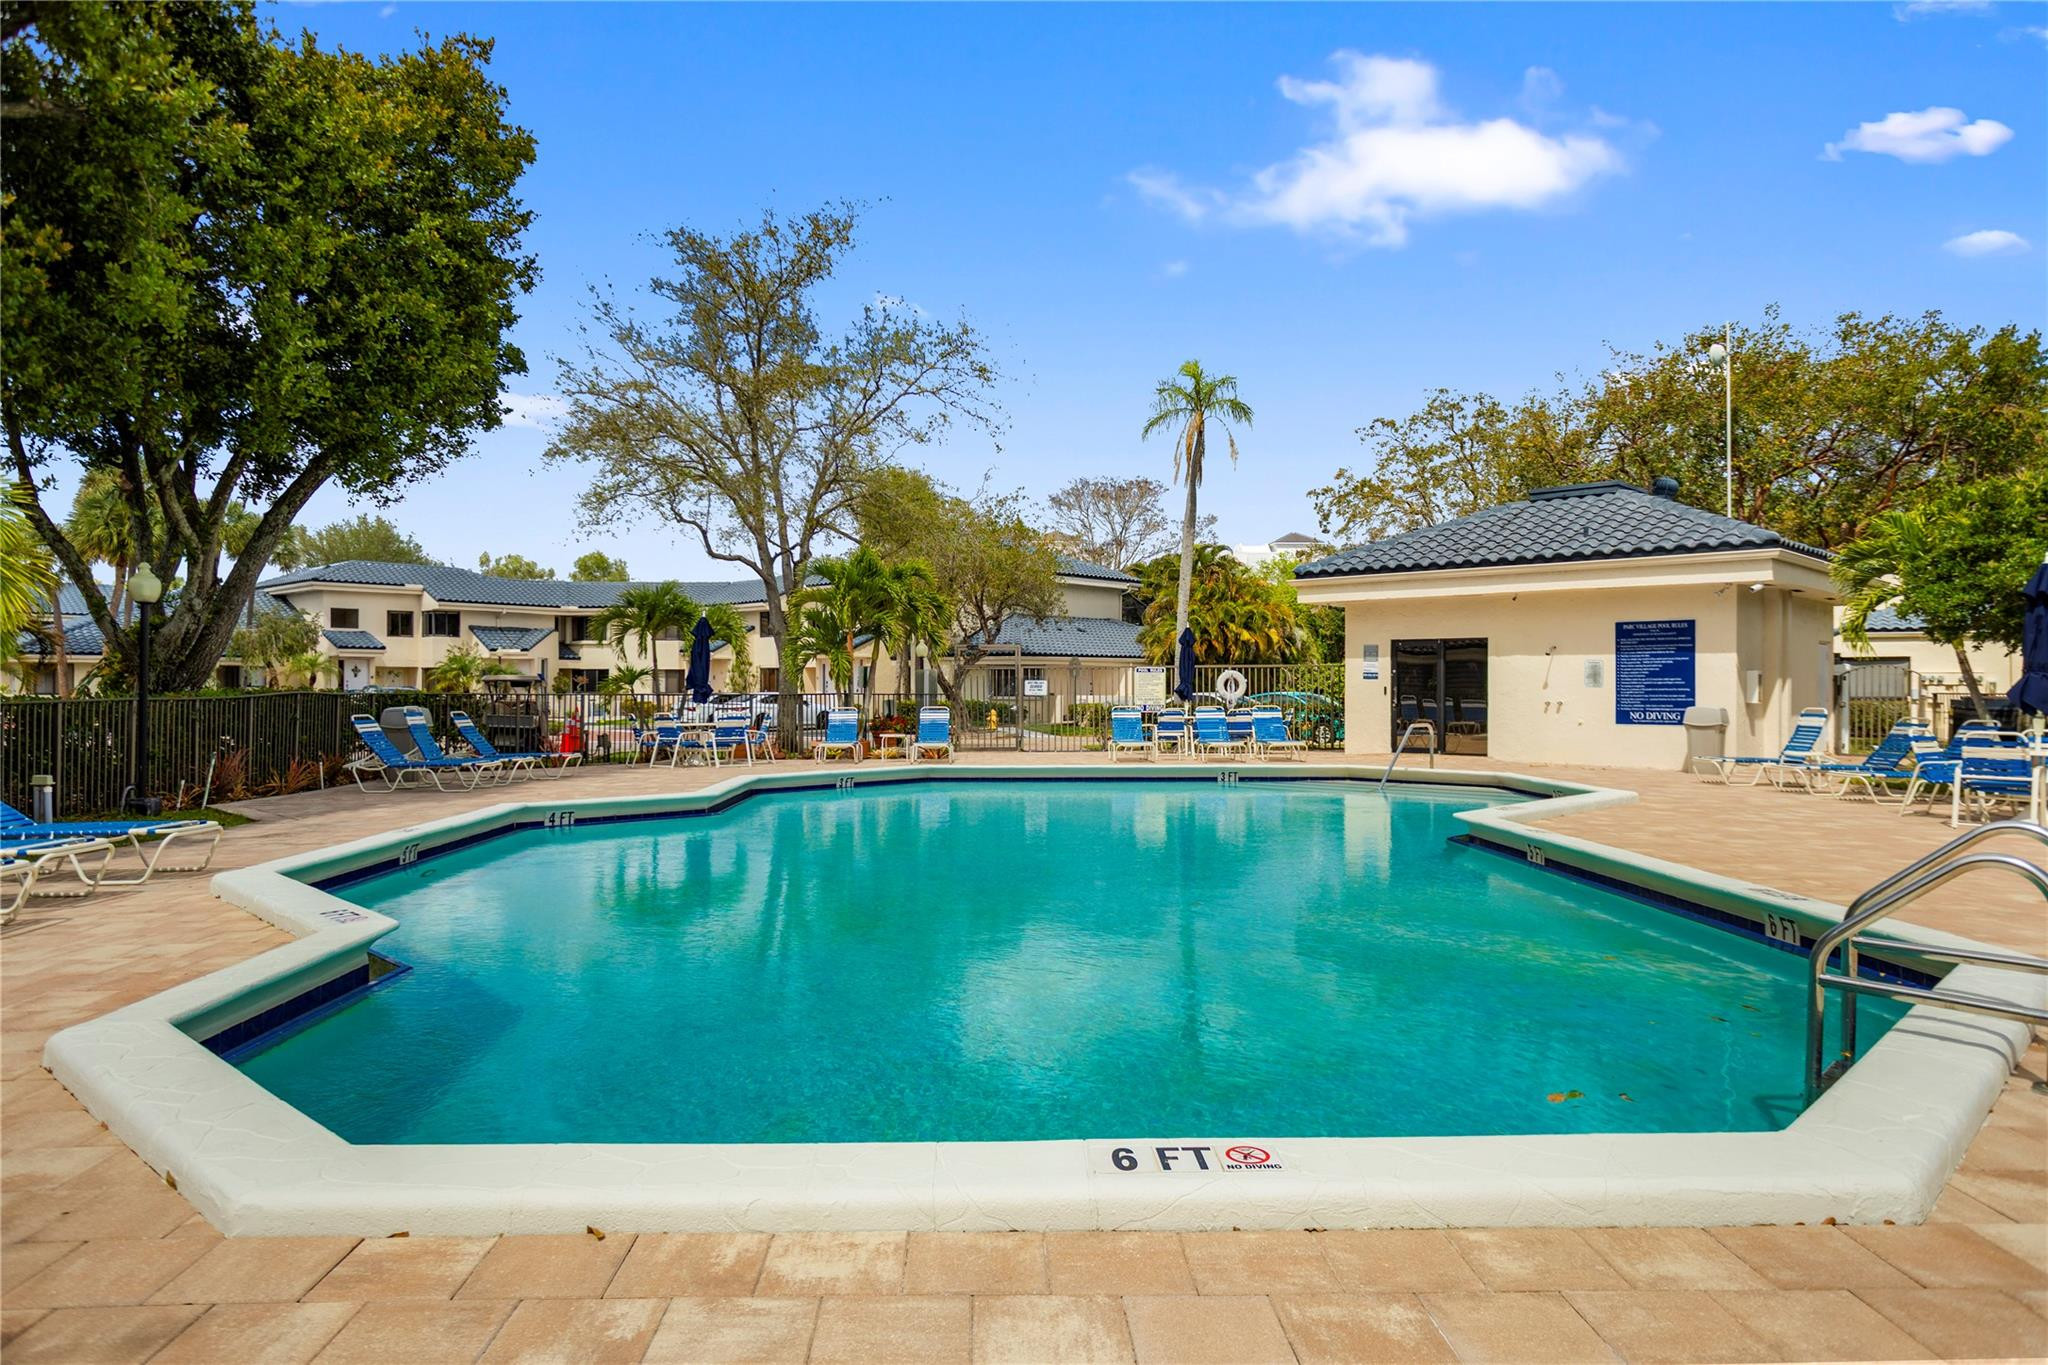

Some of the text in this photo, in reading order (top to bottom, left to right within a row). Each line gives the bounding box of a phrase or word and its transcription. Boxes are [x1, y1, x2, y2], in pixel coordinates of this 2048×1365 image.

[1630, 711, 1680, 720] NO DIVING
[845, 776, 855, 788] FT
[1220, 771, 1238, 782] 3 FT
[549, 811, 575, 826] 4 FT
[409, 843, 420, 862] FT
[1534, 845, 1544, 863] FT
[1768, 913, 1796, 943] 6 FT
[1111, 1146, 1211, 1171] 6 FT
